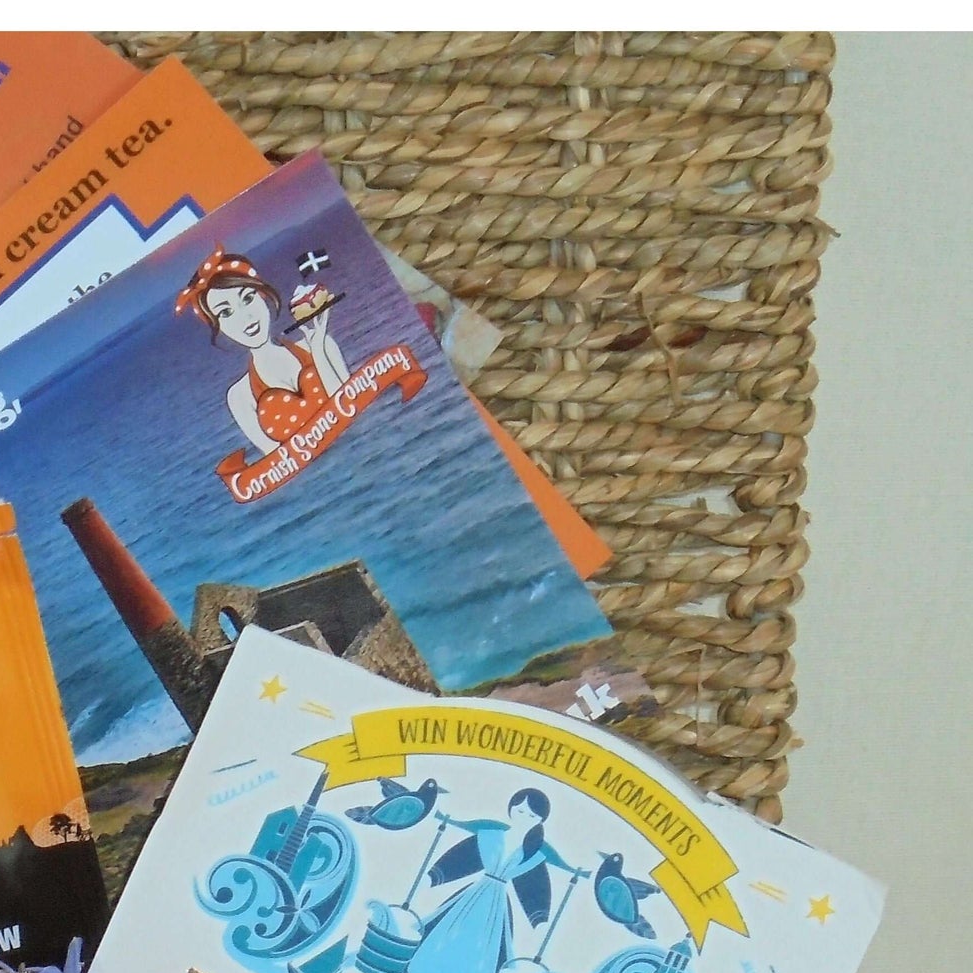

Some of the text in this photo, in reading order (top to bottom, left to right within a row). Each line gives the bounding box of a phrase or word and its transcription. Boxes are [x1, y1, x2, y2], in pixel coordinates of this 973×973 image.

[4, 168, 110, 263] cream
[104, 117, 173, 169] tea.
[231, 347, 411, 500] Cornish Scone Company
[398, 718, 702, 857] WIN WONDERFUL MOMENTS
